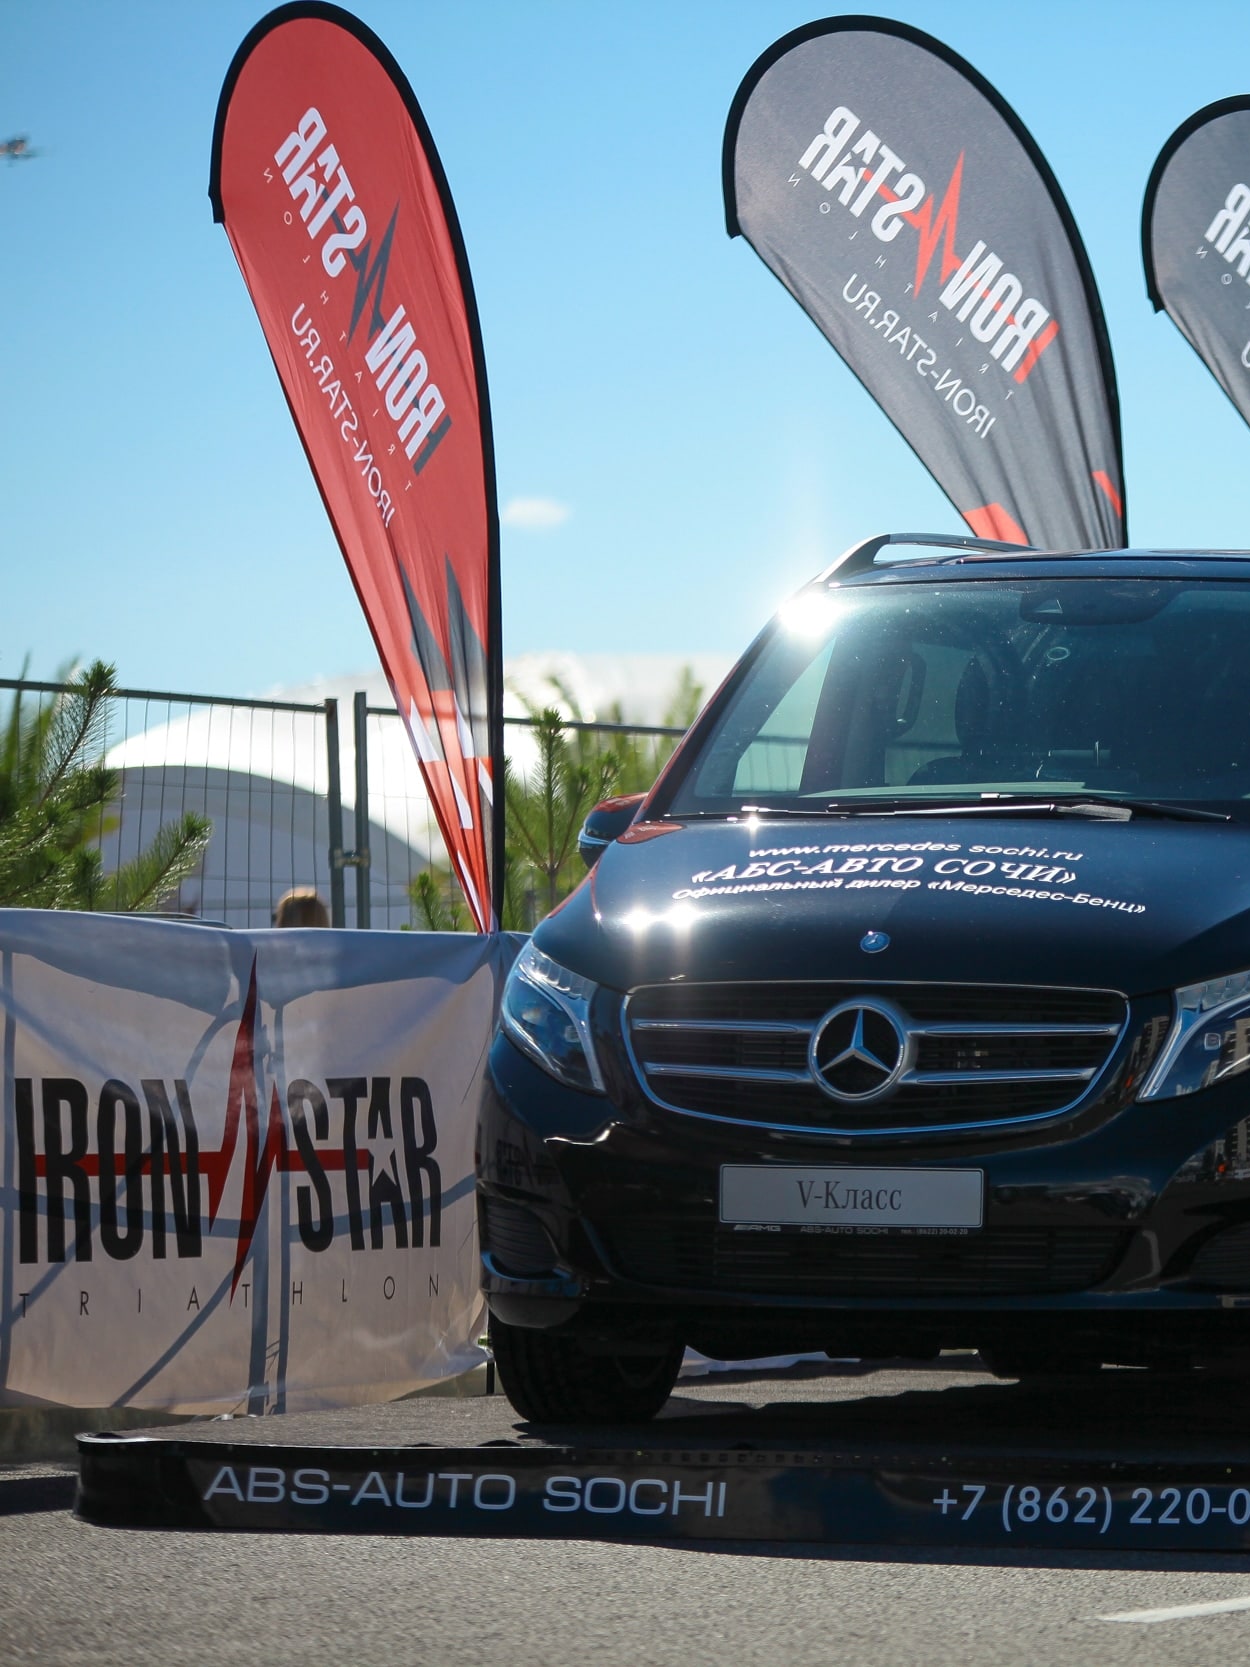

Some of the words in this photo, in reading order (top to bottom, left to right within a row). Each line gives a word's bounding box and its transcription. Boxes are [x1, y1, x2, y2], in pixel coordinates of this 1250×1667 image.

[933, 857, 1077, 885] СОЧИ»
[671, 877, 844, 900] Официальный
[844, 878, 922, 890] дилер
[927, 879, 1147, 914] «Мерседес-Бенц»
[13, 1077, 204, 1265] IRON
[287, 1076, 442, 1253] STAR
[796, 1179, 902, 1211] V-Класс
[18, 1272, 441, 1319] TRIATHLON
[203, 1466, 517, 1510] ABS-AUTO
[542, 1476, 728, 1518] SOCHI
[932, 1484, 987, 1521] +7
[1001, 1484, 1114, 1533] (862)
